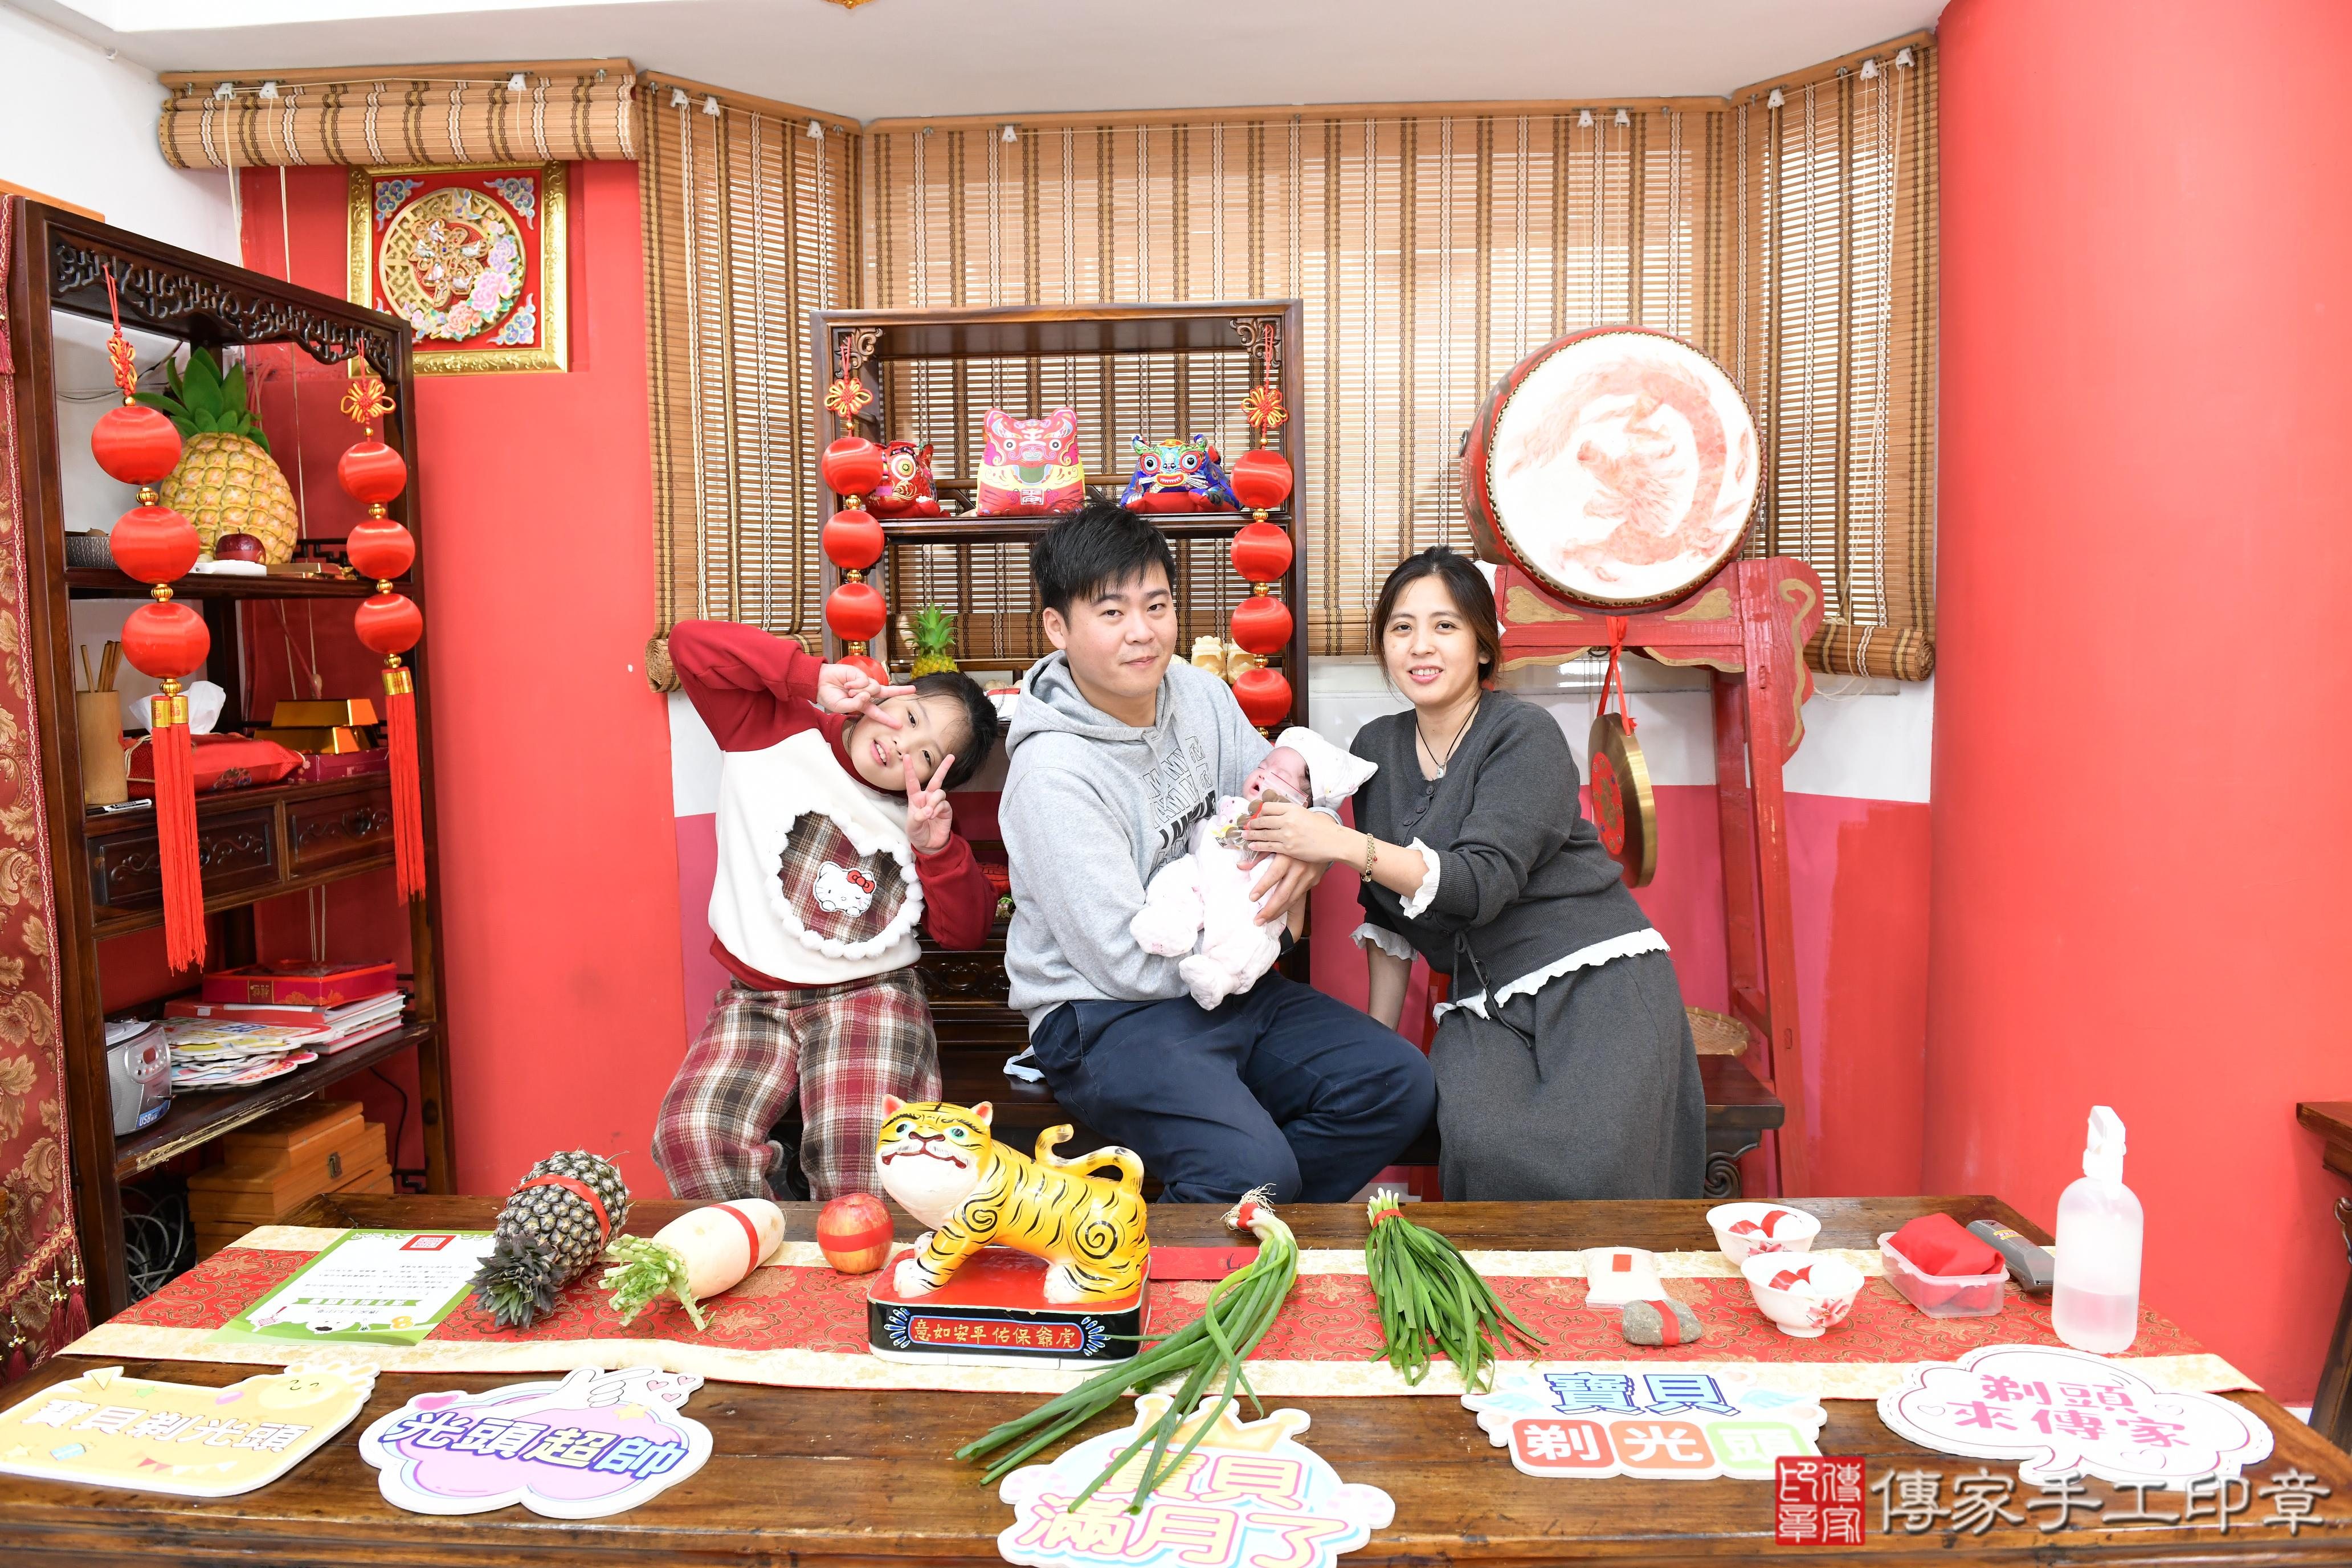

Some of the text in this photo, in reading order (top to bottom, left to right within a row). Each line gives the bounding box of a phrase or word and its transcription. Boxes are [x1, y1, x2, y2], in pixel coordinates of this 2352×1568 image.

[140, 1114, 151, 1126] USB
[1544, 1372, 1741, 1416] 寶貝
[1981, 1374, 2134, 1414] 剃頭
[21, 1399, 313, 1452] 寶貝剃光頭
[377, 1411, 688, 1479] 光頭超帥
[1524, 1423, 1797, 1463] 剃光頭
[1946, 1401, 2190, 1447] 來傳家
[1014, 1493, 1349, 1568] 滿月了
